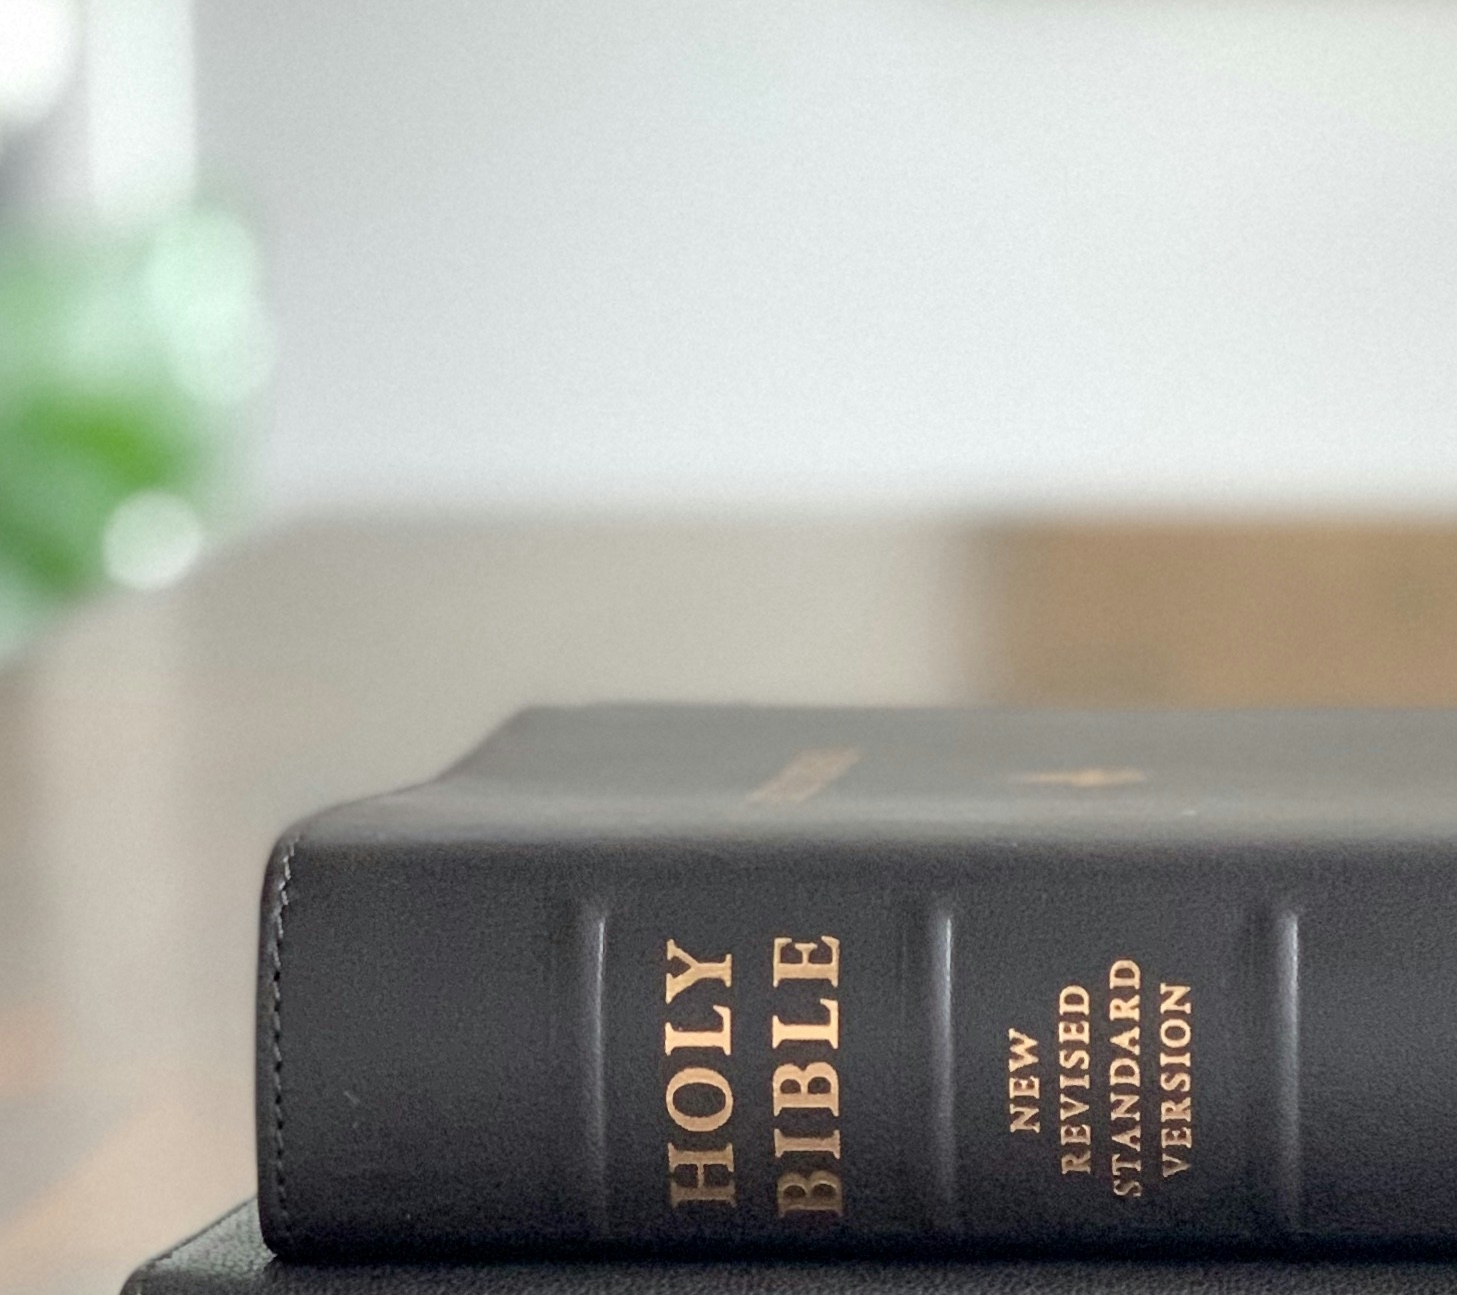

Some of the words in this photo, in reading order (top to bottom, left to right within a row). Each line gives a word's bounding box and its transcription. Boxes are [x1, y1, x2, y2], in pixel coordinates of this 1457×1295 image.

[665, 937, 739, 1207] HOLY
[771, 934, 843, 1218] BIBLE
[1008, 1028, 1041, 1134] NEW
[1058, 984, 1092, 1175] REVISED
[1108, 958, 1143, 1197] STANDARD
[1158, 982, 1193, 1178] VERSION
